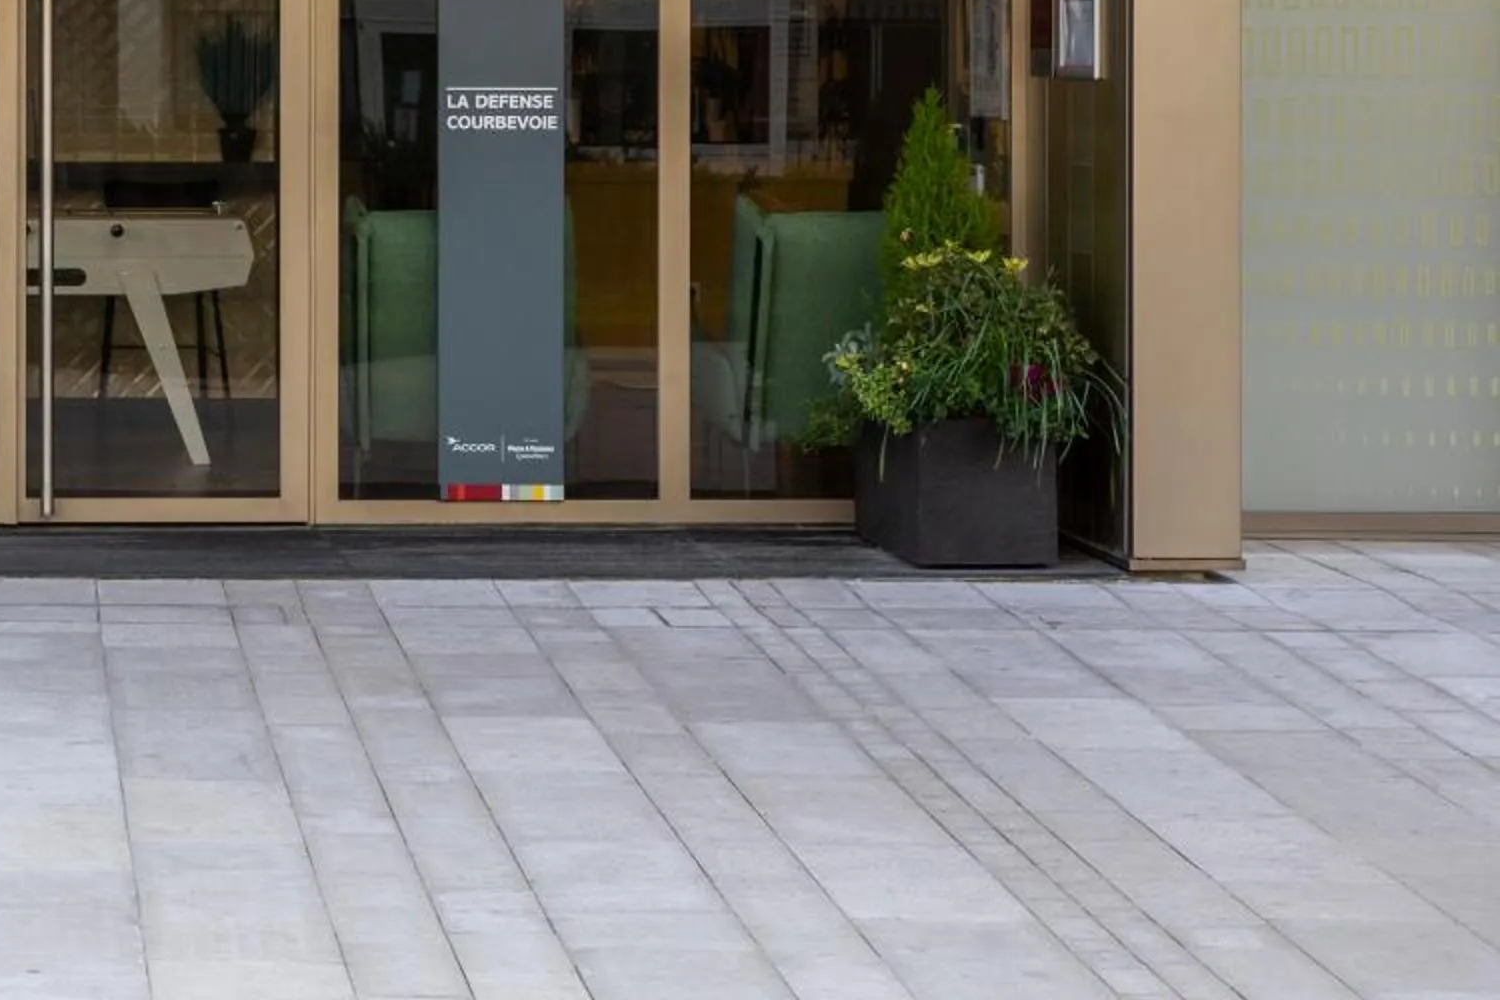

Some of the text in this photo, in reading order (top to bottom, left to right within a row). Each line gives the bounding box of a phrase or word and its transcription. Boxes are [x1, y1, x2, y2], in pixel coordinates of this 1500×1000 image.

[447, 94, 554, 109] LA DEFENSE
[446, 115, 558, 129] COURBEVOIE
[452, 443, 496, 452] ACCOR
